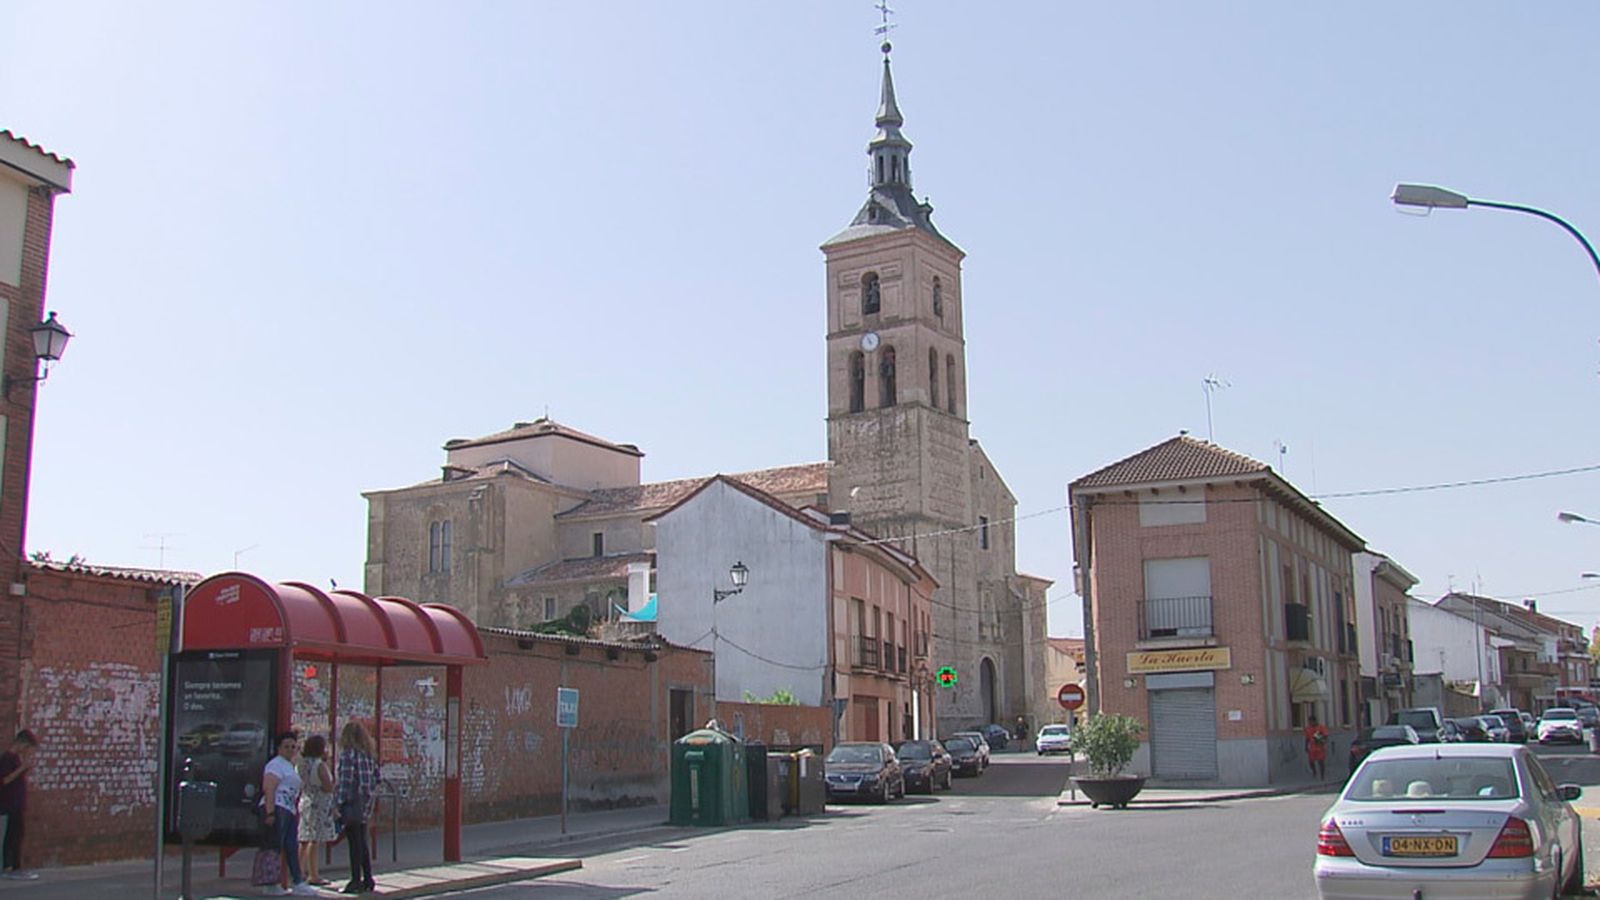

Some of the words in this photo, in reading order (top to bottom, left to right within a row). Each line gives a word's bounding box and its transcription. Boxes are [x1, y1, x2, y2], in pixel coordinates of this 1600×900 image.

[1139, 654, 1158, 664] La
[1161, 651, 1214, 664] Huerta
[184, 681, 211, 690] Siempre
